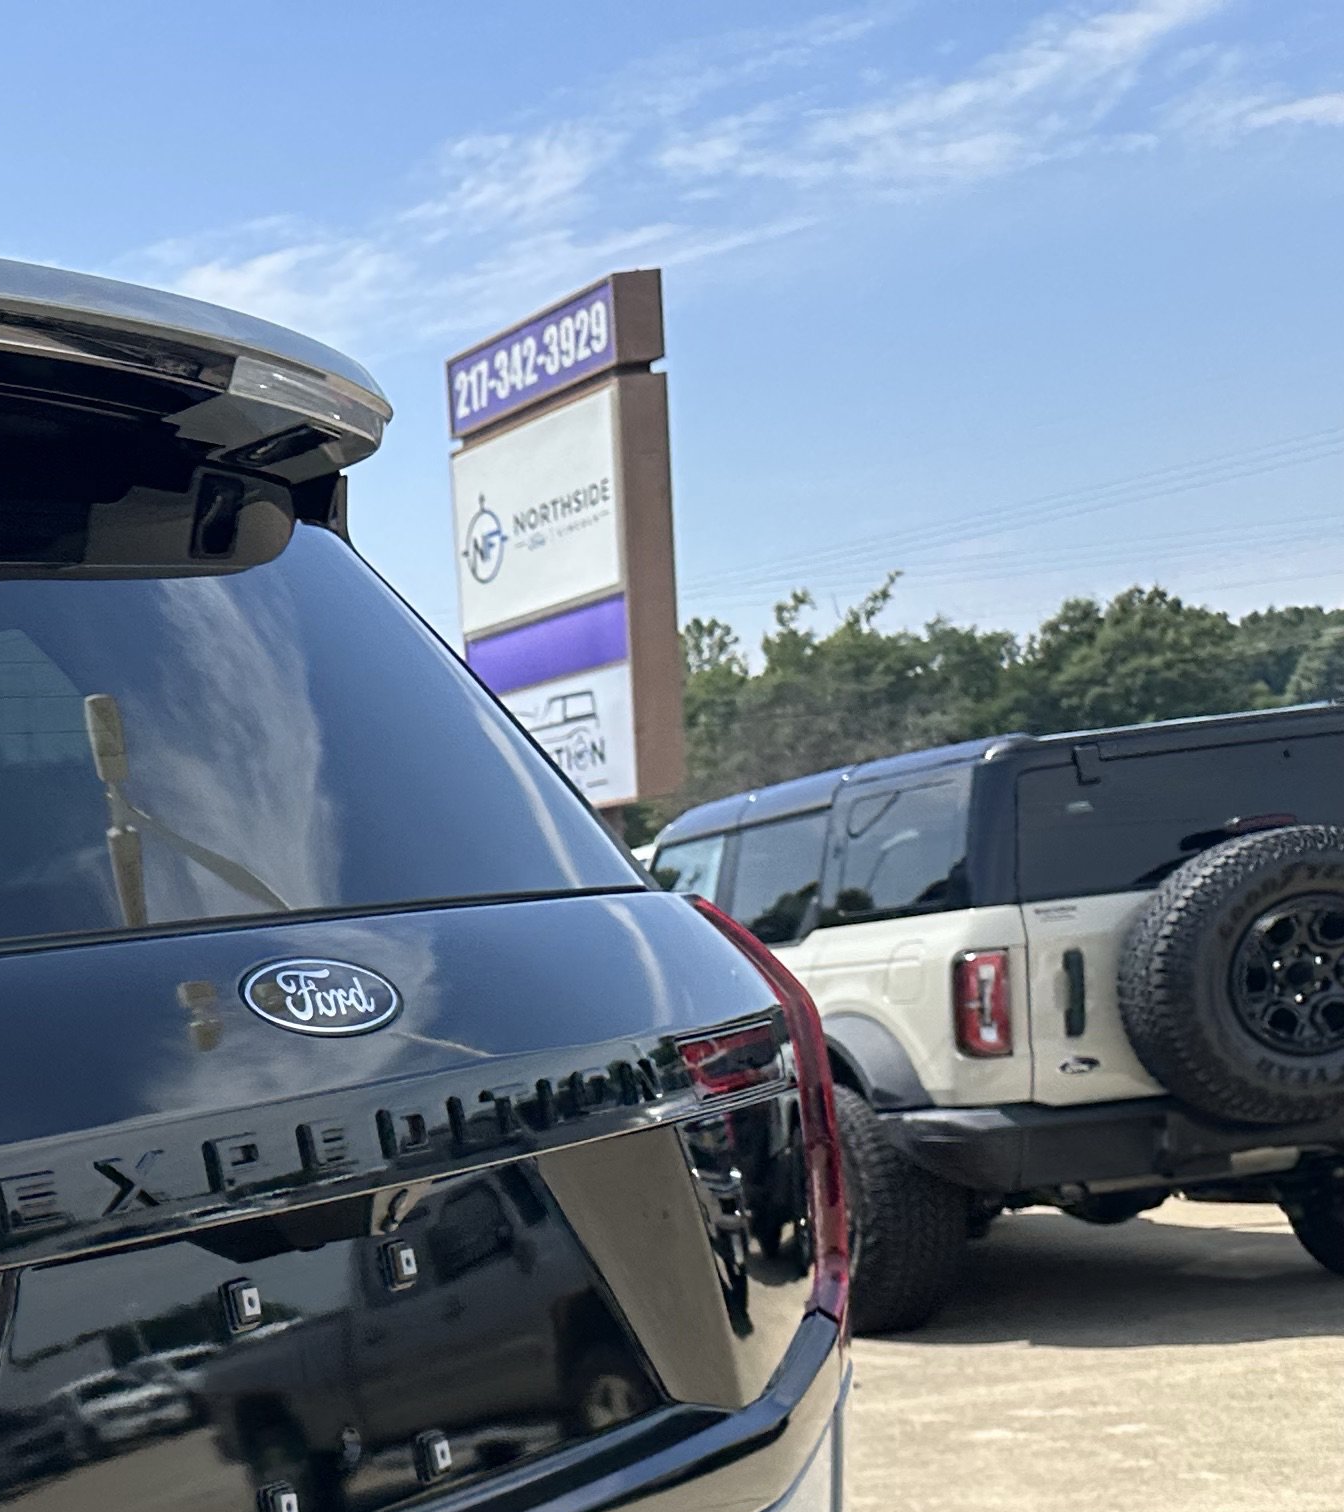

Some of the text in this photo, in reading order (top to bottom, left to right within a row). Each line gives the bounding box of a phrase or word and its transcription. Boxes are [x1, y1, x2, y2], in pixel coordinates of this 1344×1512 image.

[454, 300, 608, 419] 217-342-3929
[513, 477, 610, 535] NORTHSIDE
[275, 968, 376, 1021] Ford
